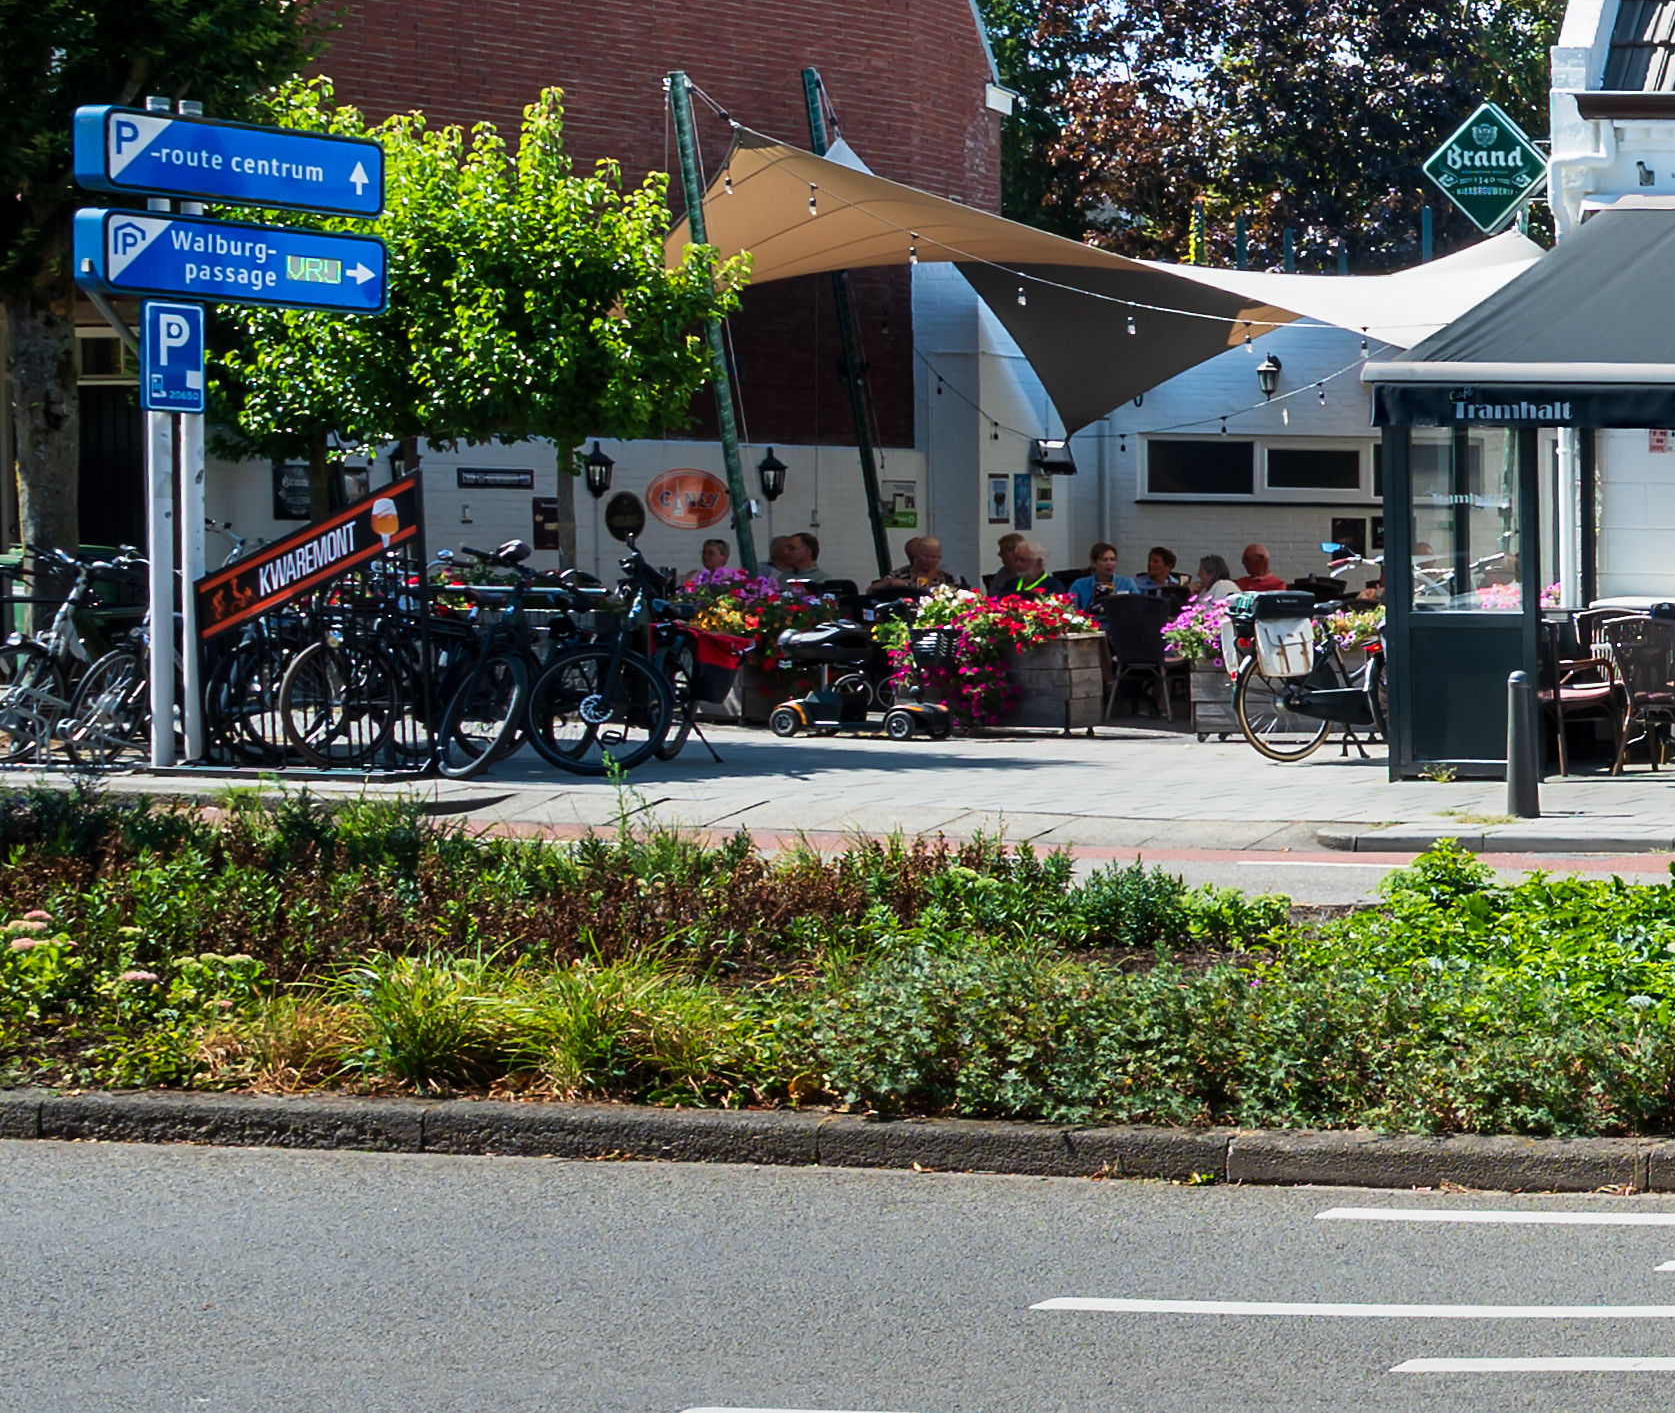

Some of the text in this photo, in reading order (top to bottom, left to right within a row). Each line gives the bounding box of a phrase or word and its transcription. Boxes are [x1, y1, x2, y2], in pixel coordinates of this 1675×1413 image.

[231, 156, 324, 182] centrum
[1446, 143, 1525, 170] Brand
[170, 230, 277, 264] Walburg-
[185, 263, 277, 290] passage
[160, 313, 190, 366] P
[1451, 401, 1573, 420] Tramhalt
[258, 520, 356, 597] KWAREMONT
